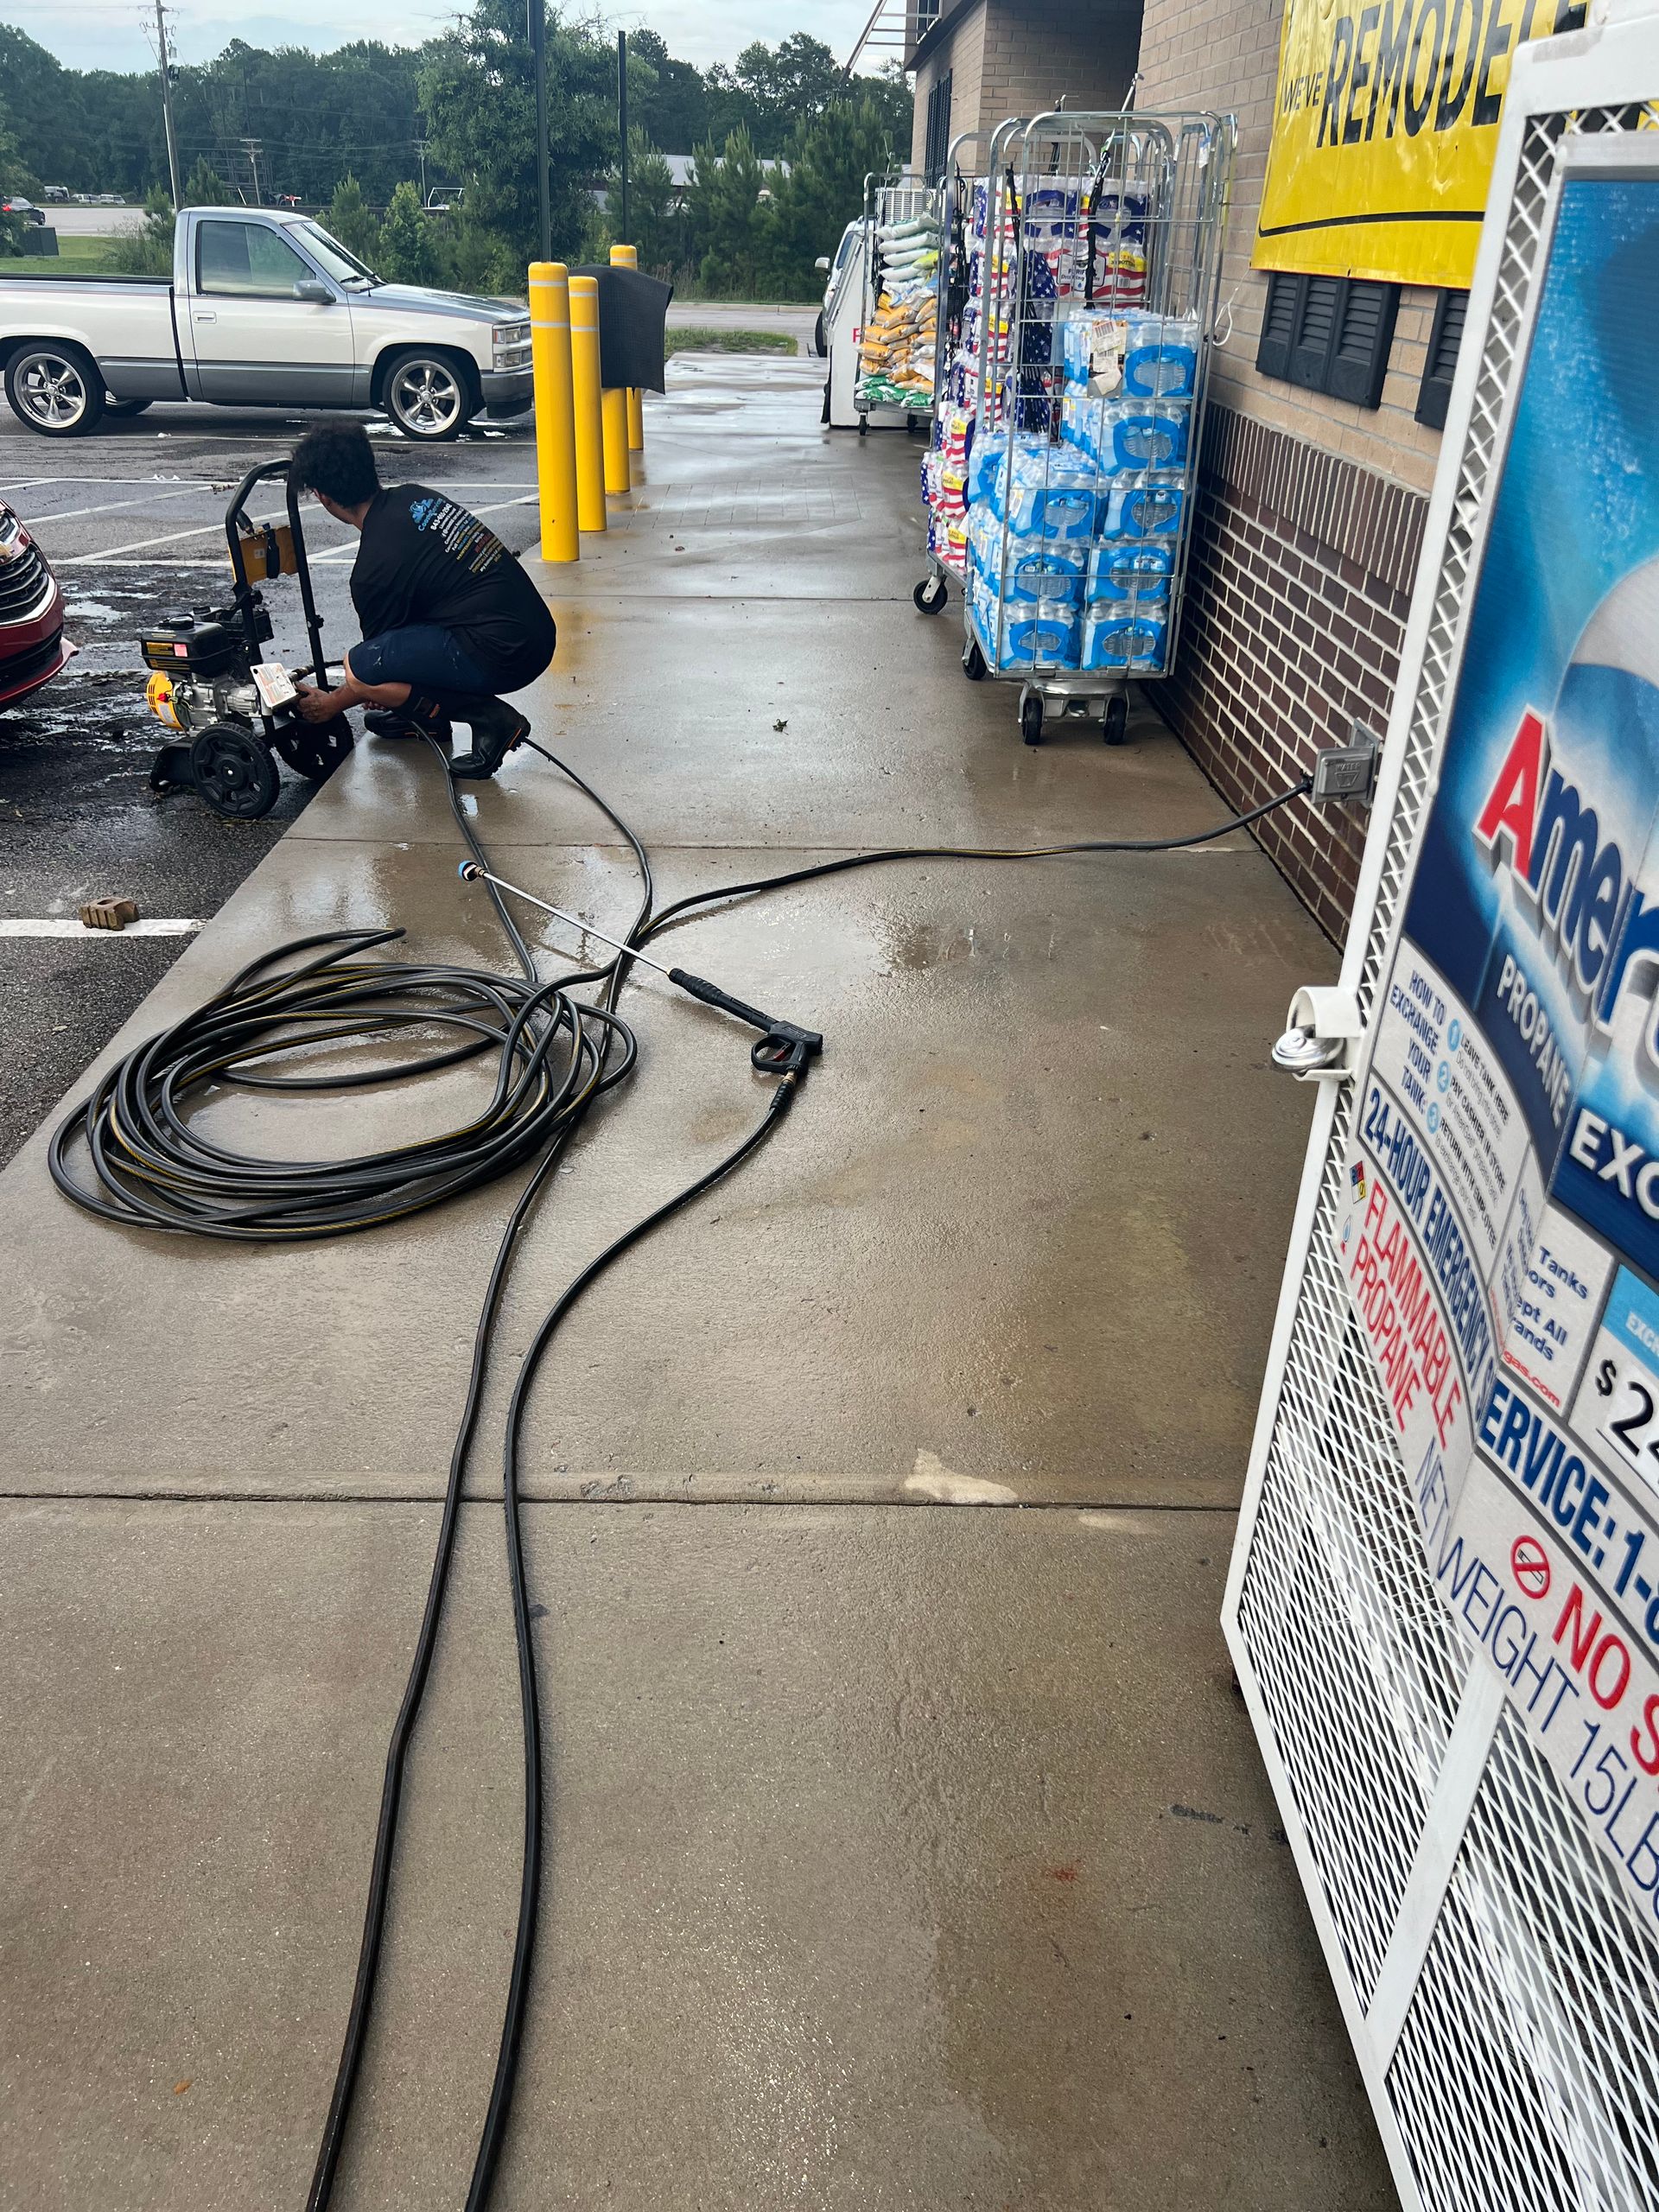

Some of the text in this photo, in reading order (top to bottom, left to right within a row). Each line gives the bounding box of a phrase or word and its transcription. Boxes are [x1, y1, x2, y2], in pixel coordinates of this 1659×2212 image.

[1281, 70, 1324, 113] WE'VE
[1471, 704, 1659, 1071] Amer
[1389, 983, 1440, 1056] EXCHANGE
[1408, 969, 1447, 1027] HOW TO
[1497, 953, 1570, 1129] PROPANE
[1407, 1037, 1432, 1084] YOUR
[1460, 1033, 1480, 1070] LEAVE
[1478, 1061, 1495, 1097] TANK
[1493, 1090, 1509, 1126] HERE
[1439, 1116, 1462, 1164] RETURN
[1460, 1157, 1475, 1191] WITH
[1473, 1186, 1497, 1251] EMPLOYEE
[1450, 1075, 1462, 1100] PAY
[1461, 1094, 1484, 1145] CASHIER
[1483, 1138, 1491, 1157] IN
[1489, 1151, 1506, 1196] STORE
[1363, 1087, 1431, 1225] 24-HOUR
[1422, 1183, 1490, 1391] EMERGENCY
[1538, 1244, 1589, 1300] Tanks
[1350, 1232, 1421, 1433] PROPANE
[1363, 1178, 1461, 1452] FLAMMABLE
[1543, 1317, 1568, 1346] All
[1414, 1434, 1659, 1920] NET WEIGHT 15LB
[1552, 1582, 1630, 1710] NO
